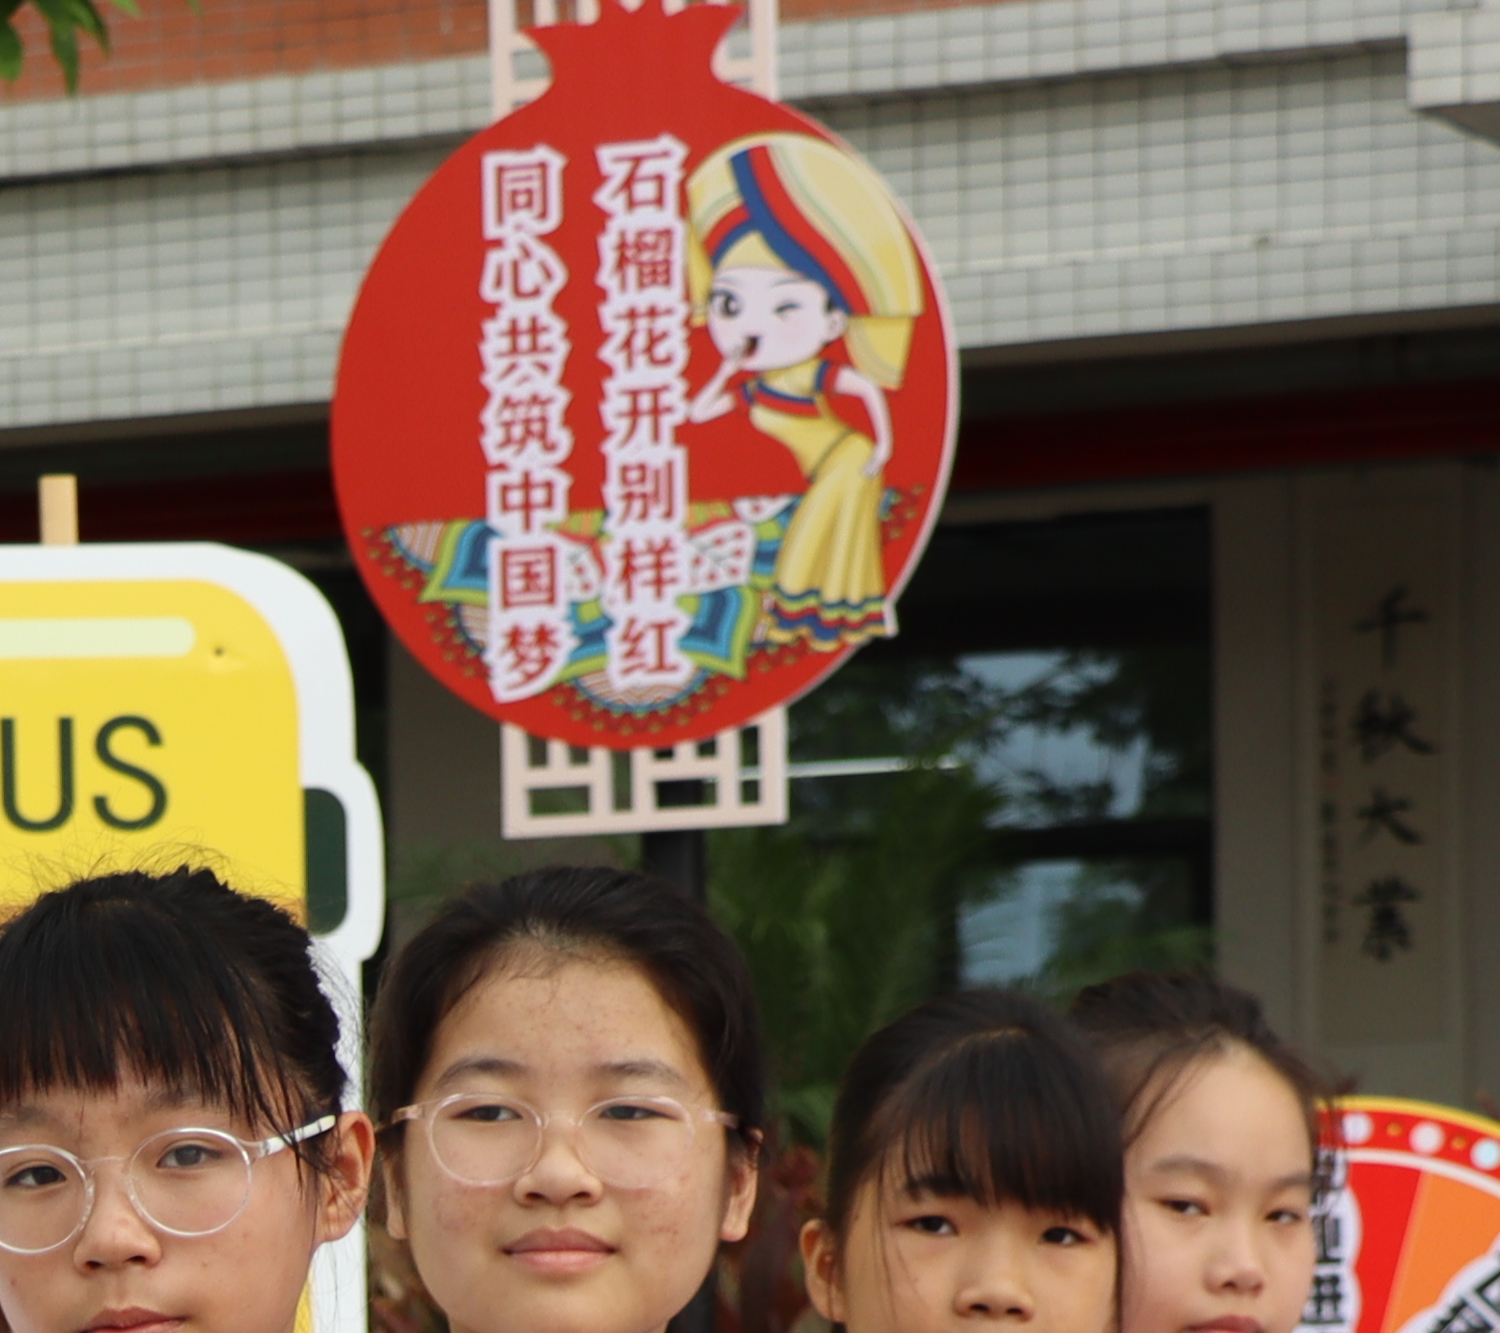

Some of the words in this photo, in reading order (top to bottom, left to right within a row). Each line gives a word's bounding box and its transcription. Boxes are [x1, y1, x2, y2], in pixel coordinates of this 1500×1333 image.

[490, 158, 562, 694] 同心共筑中国梦
[608, 144, 684, 678] 石榴花开别样红
